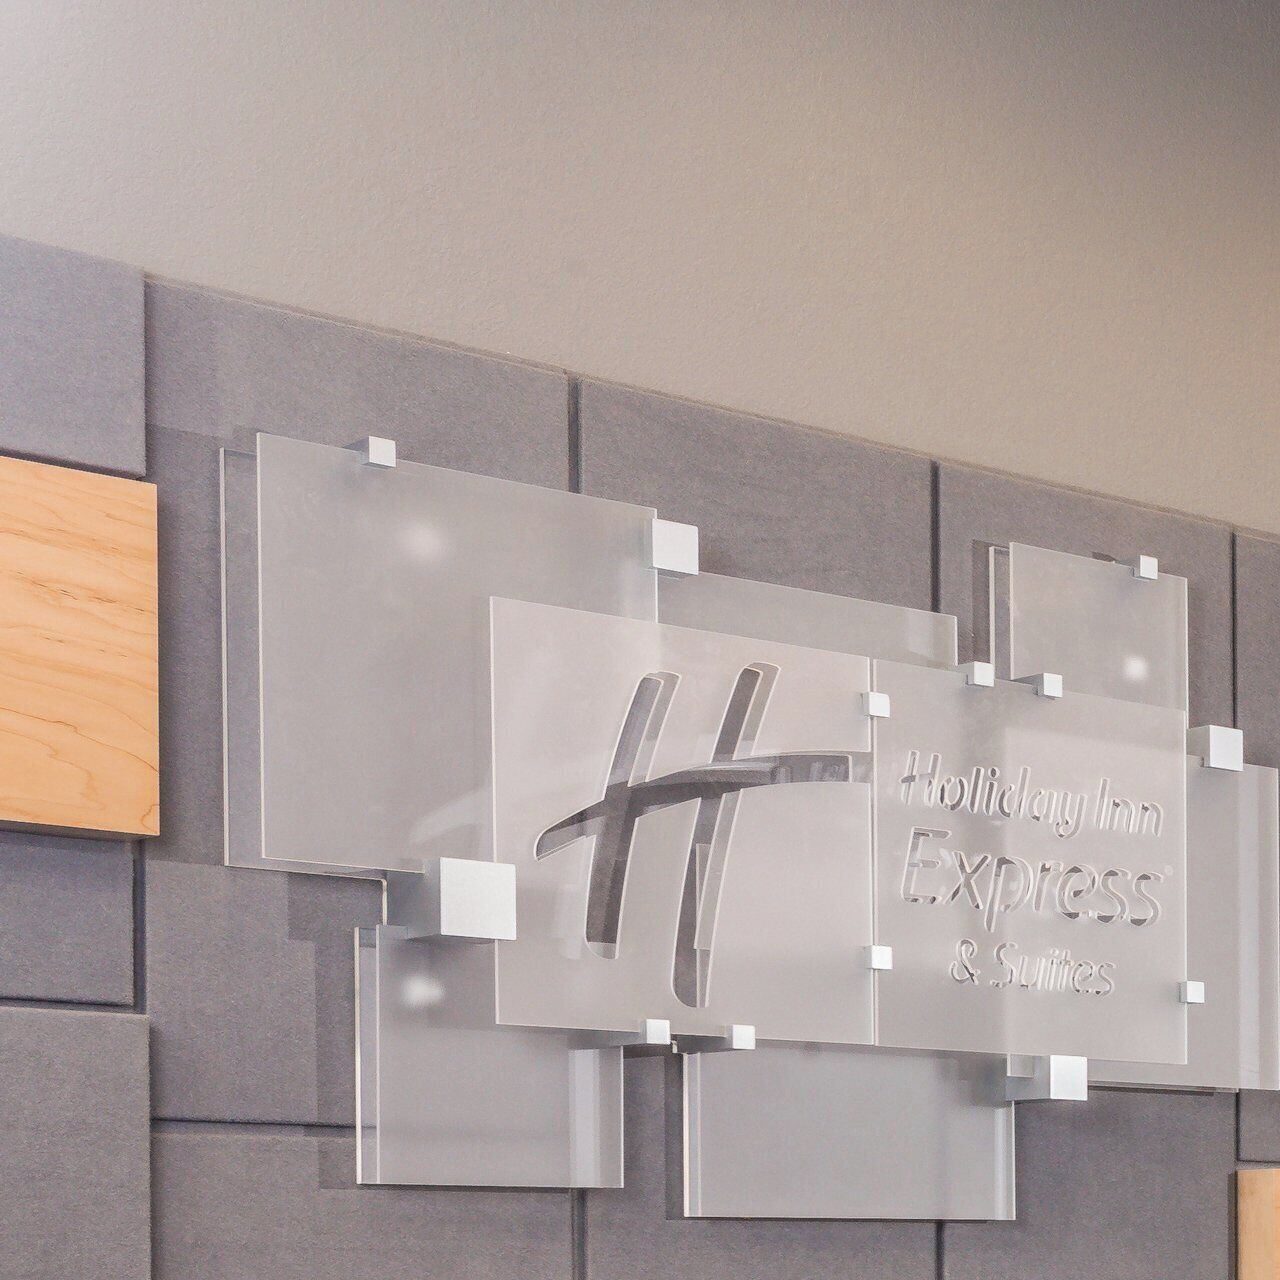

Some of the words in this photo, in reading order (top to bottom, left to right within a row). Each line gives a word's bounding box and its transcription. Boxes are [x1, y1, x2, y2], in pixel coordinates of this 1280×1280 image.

[900, 750, 1088, 839] Holiday
[1095, 776, 1164, 837] Inn
[900, 826, 1164, 933] Express
[950, 938, 981, 986] &
[990, 940, 1118, 995] Suites
